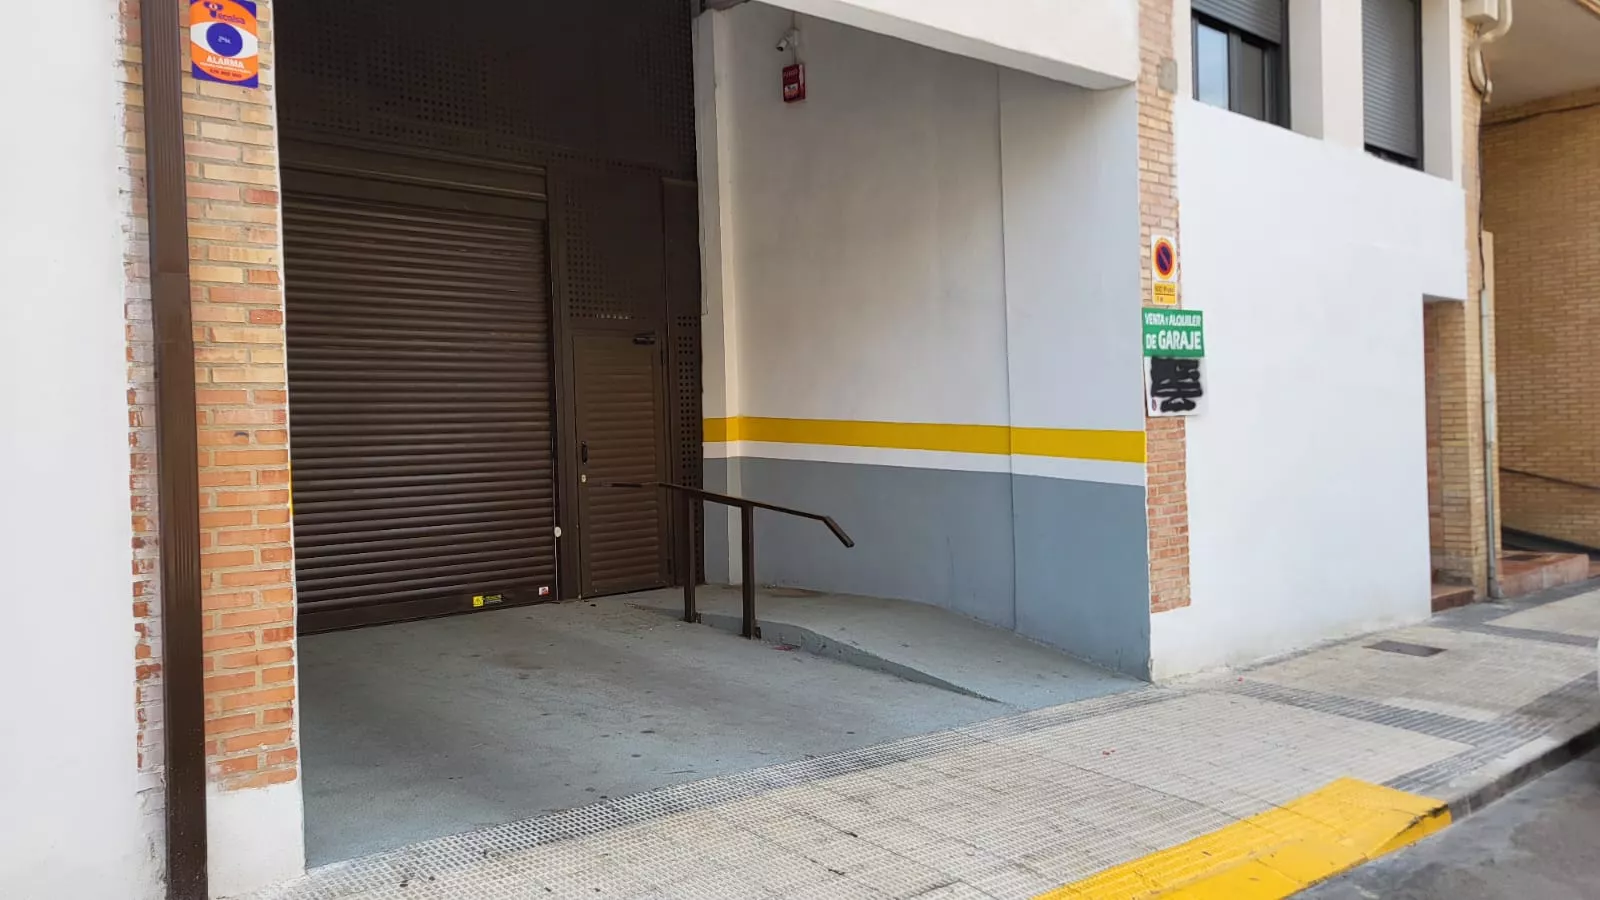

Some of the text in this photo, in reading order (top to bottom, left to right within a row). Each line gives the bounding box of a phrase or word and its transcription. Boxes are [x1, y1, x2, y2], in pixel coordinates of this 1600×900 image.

[206, 55, 245, 69] ALARMA
[1145, 312, 1165, 326] VENTA
[1169, 314, 1202, 327] ALQUILER
[1145, 330, 1202, 350] DE GARAJE
